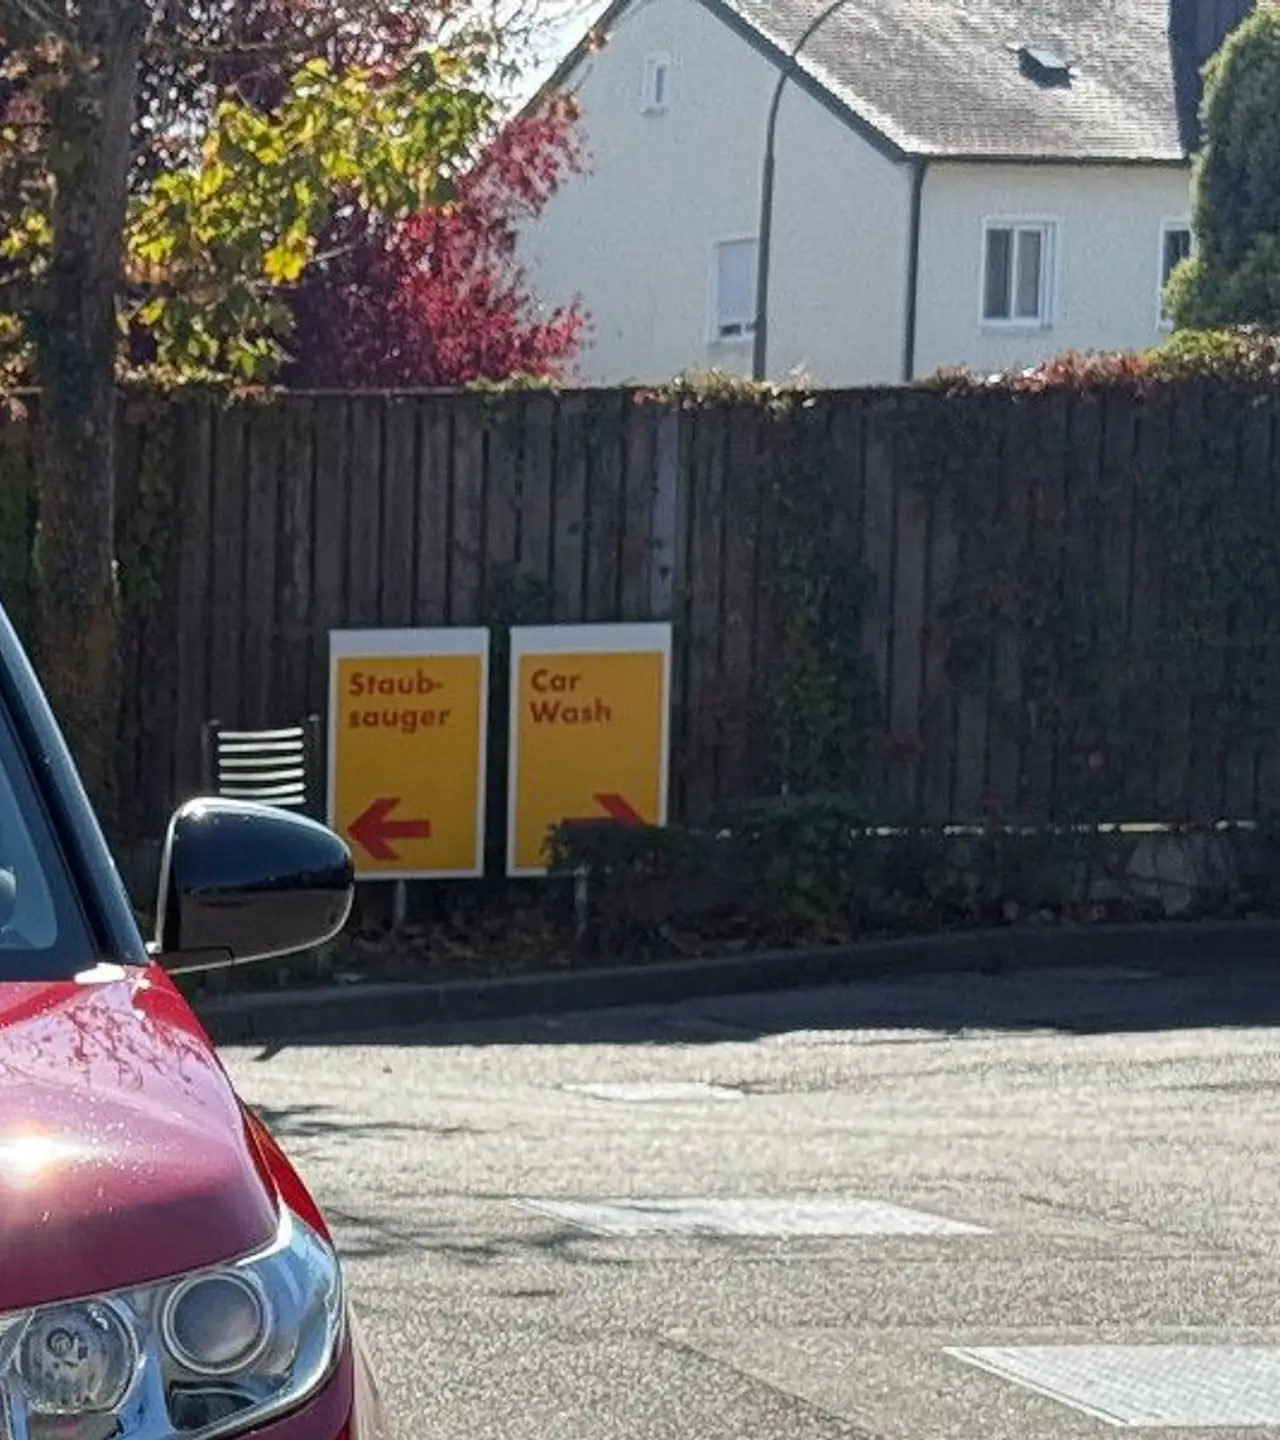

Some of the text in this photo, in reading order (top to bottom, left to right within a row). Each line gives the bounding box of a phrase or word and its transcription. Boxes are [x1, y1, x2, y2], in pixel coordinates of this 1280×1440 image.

[348, 669, 444, 696] Staub-
[530, 669, 582, 693] Car
[348, 707, 451, 734] sauger
[531, 700, 613, 724] Wash
